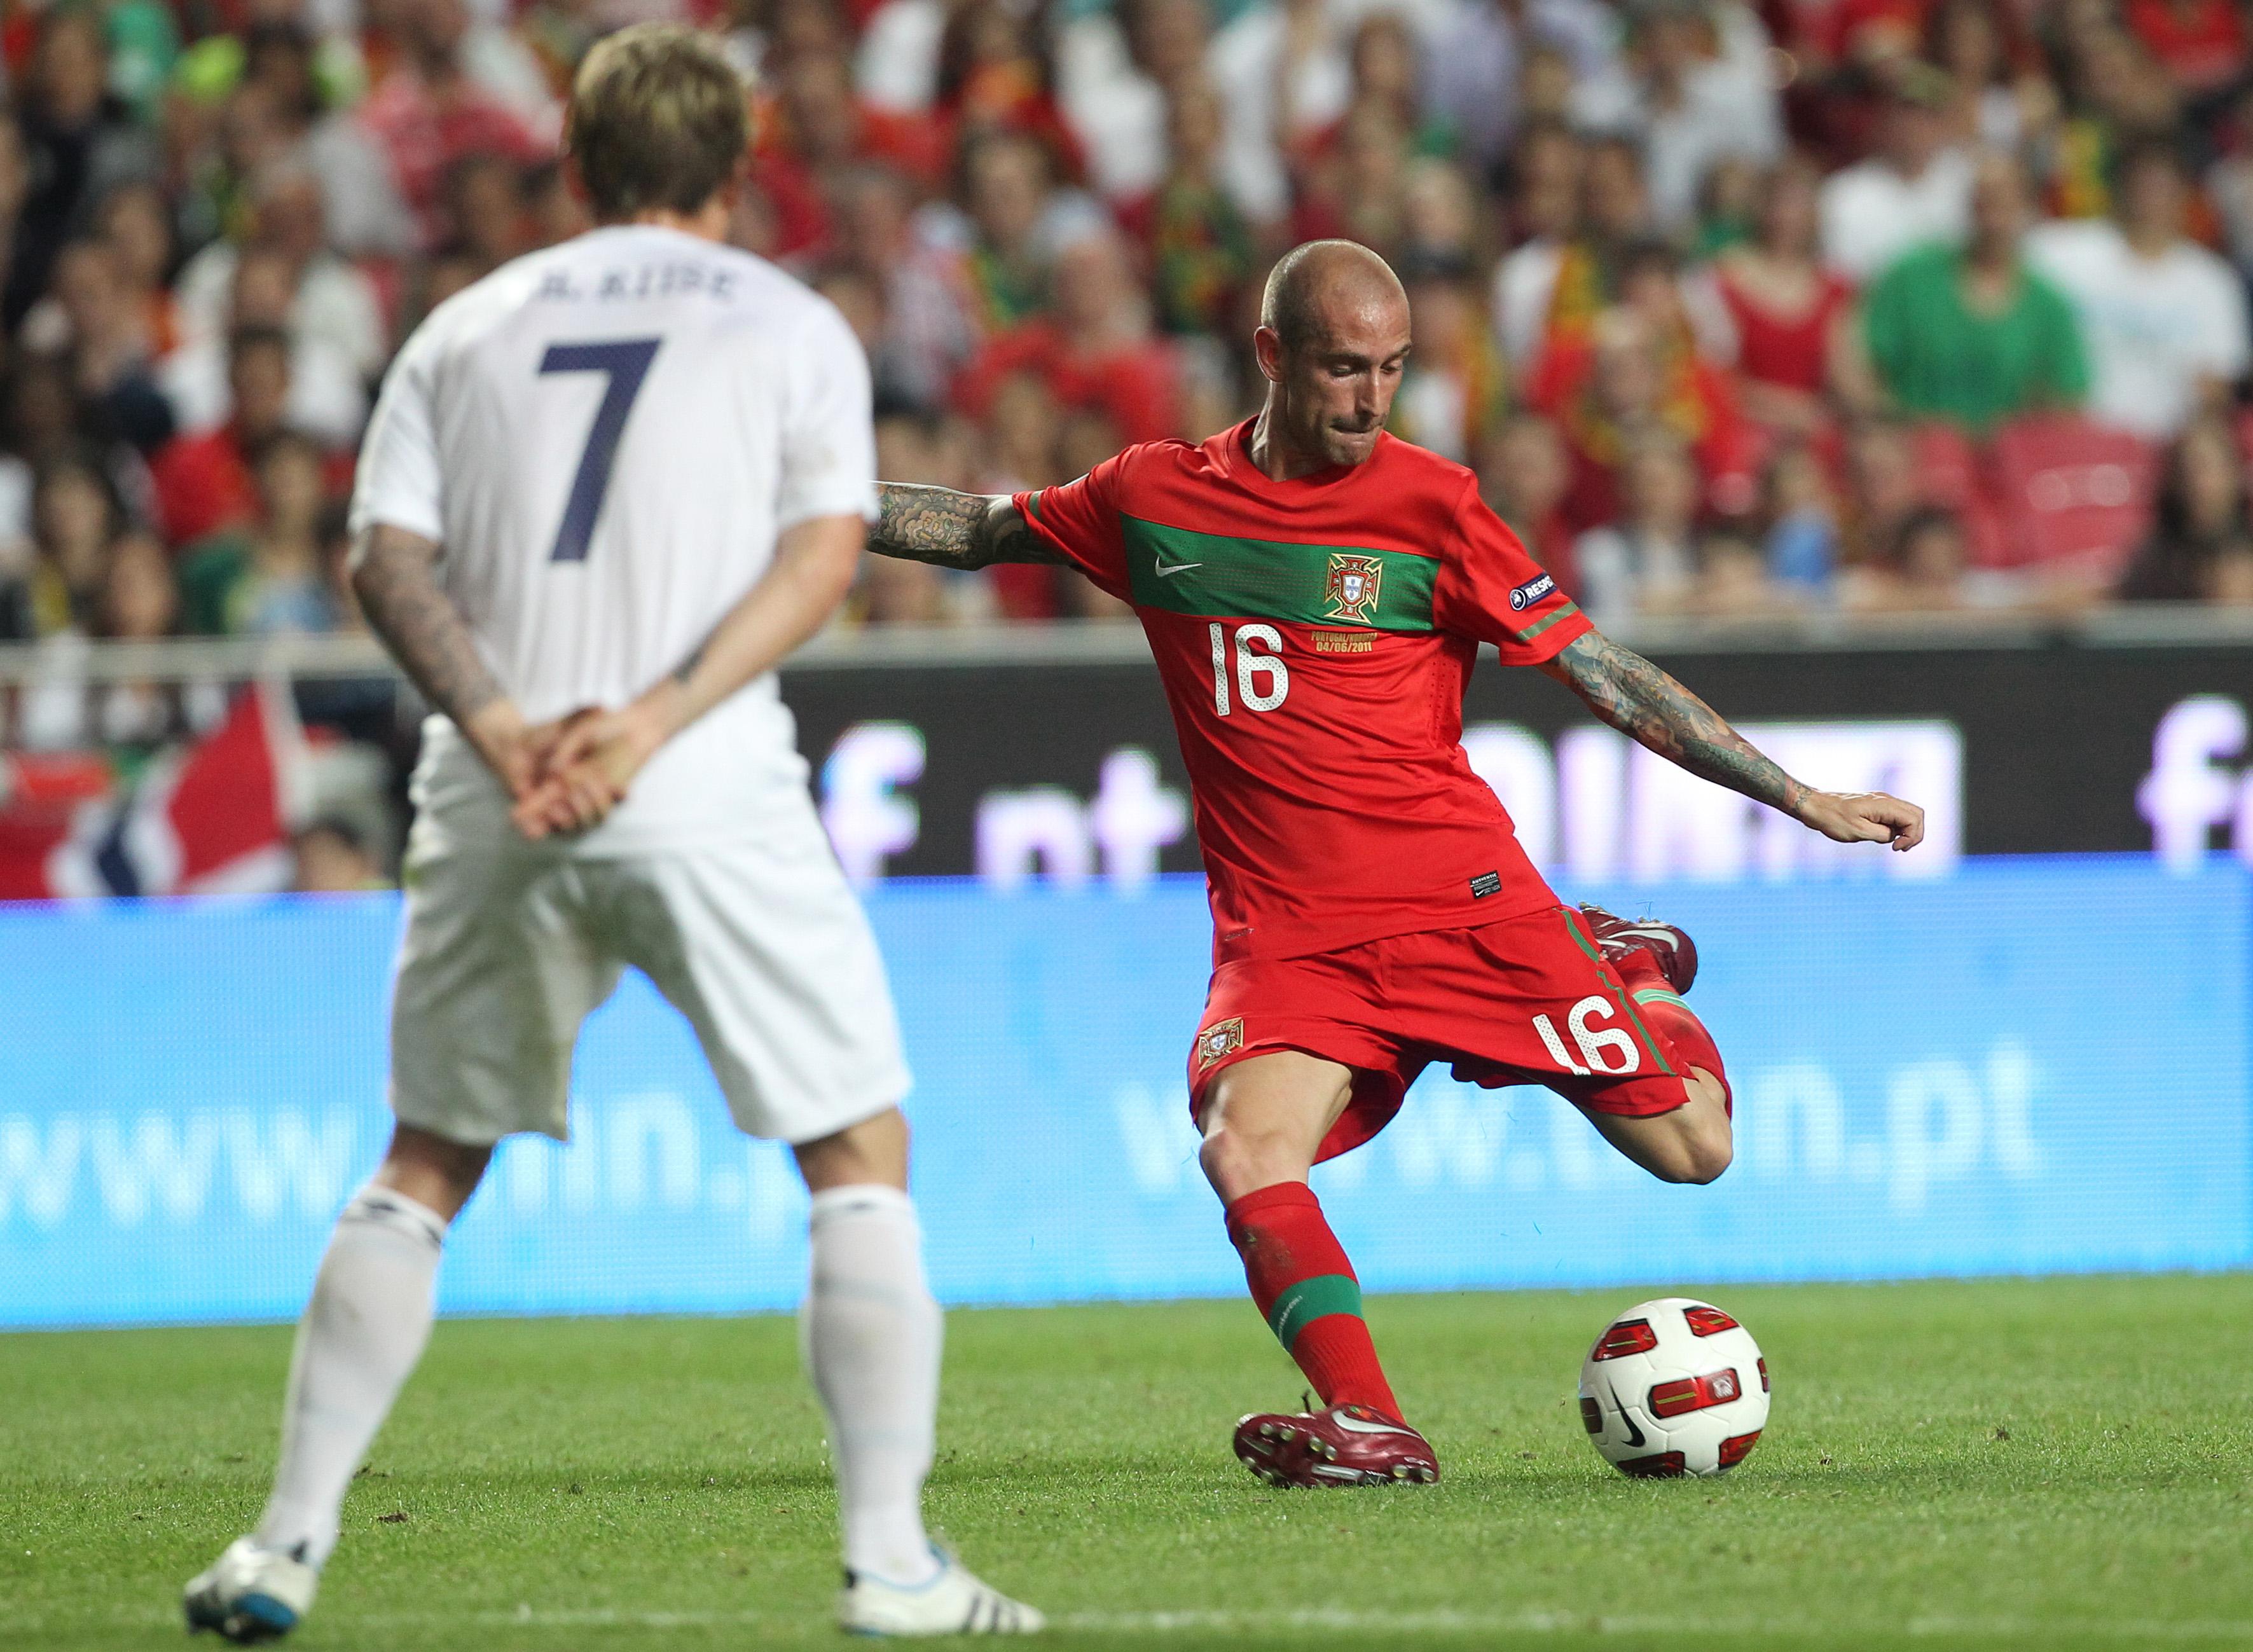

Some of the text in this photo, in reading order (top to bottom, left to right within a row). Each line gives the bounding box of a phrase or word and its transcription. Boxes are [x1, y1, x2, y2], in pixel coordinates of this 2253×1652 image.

[539, 338, 662, 562] 7
[1524, 574, 1554, 600] RESPE
[1208, 622, 1290, 717] 16
[1316, 640, 1372, 653] 04/06/2011
[1531, 995, 1641, 1076] 16
